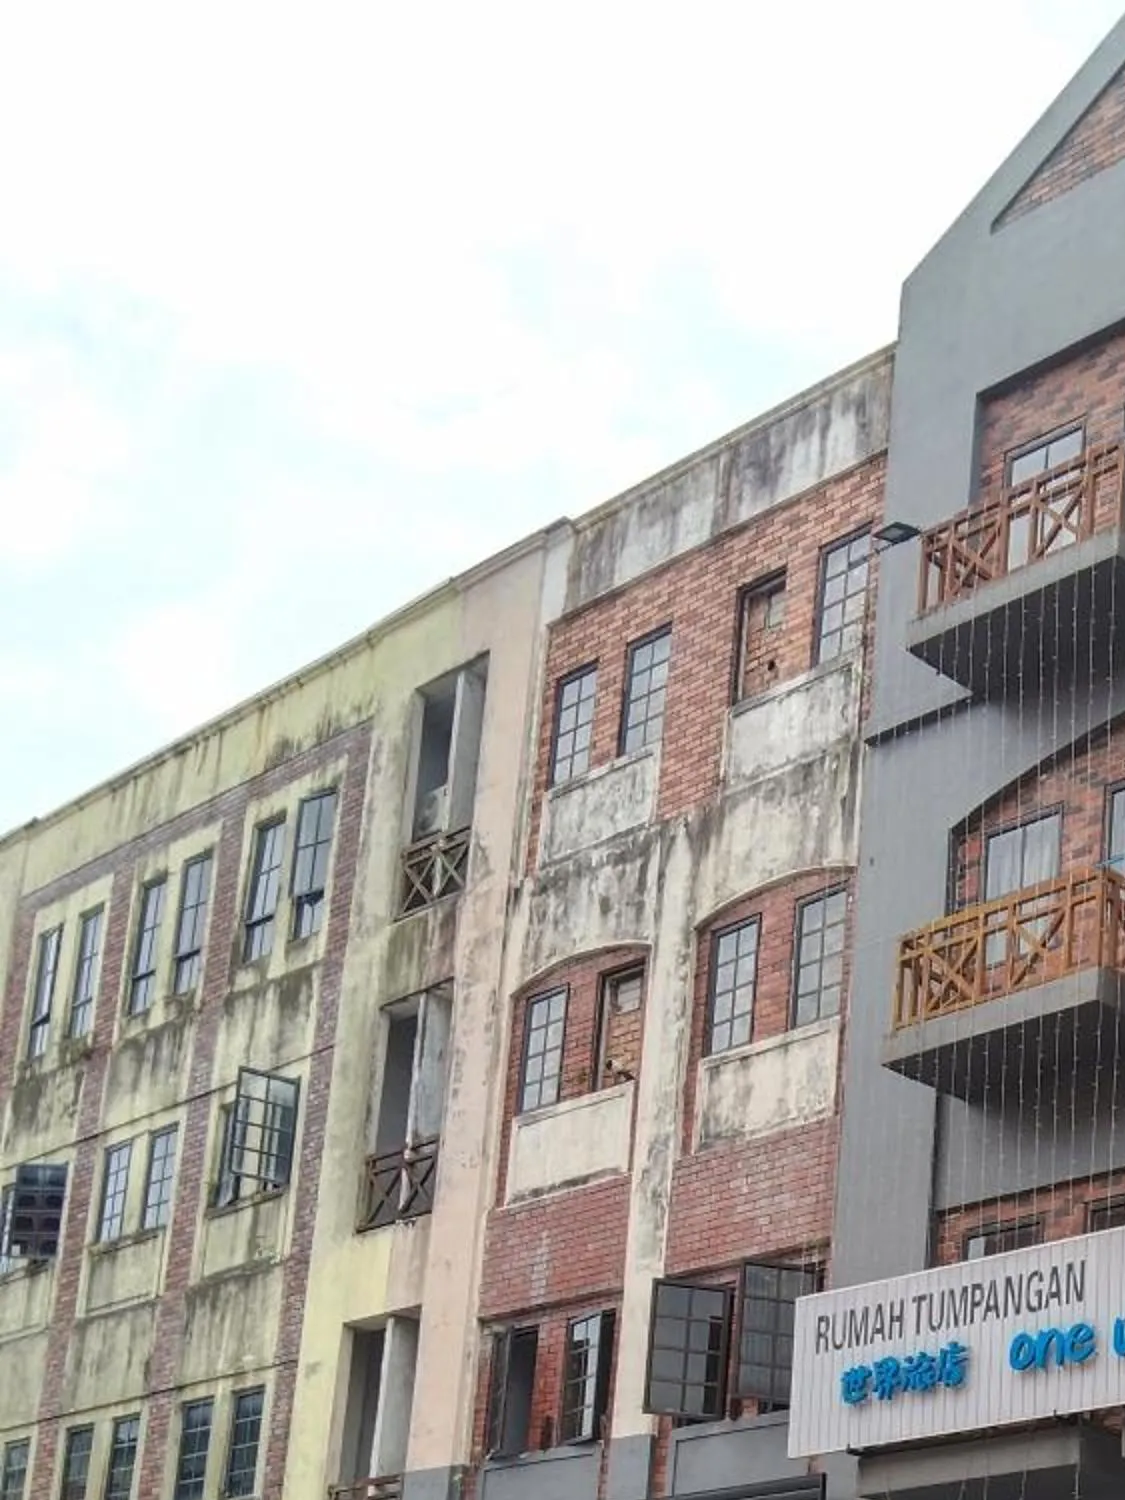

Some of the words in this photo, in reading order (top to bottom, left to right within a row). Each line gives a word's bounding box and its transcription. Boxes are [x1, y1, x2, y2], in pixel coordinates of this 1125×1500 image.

[816, 1292, 904, 1354] RUMAH
[911, 1259, 1088, 1338] TUMPANGAN
[1009, 1322, 1096, 1371] one
